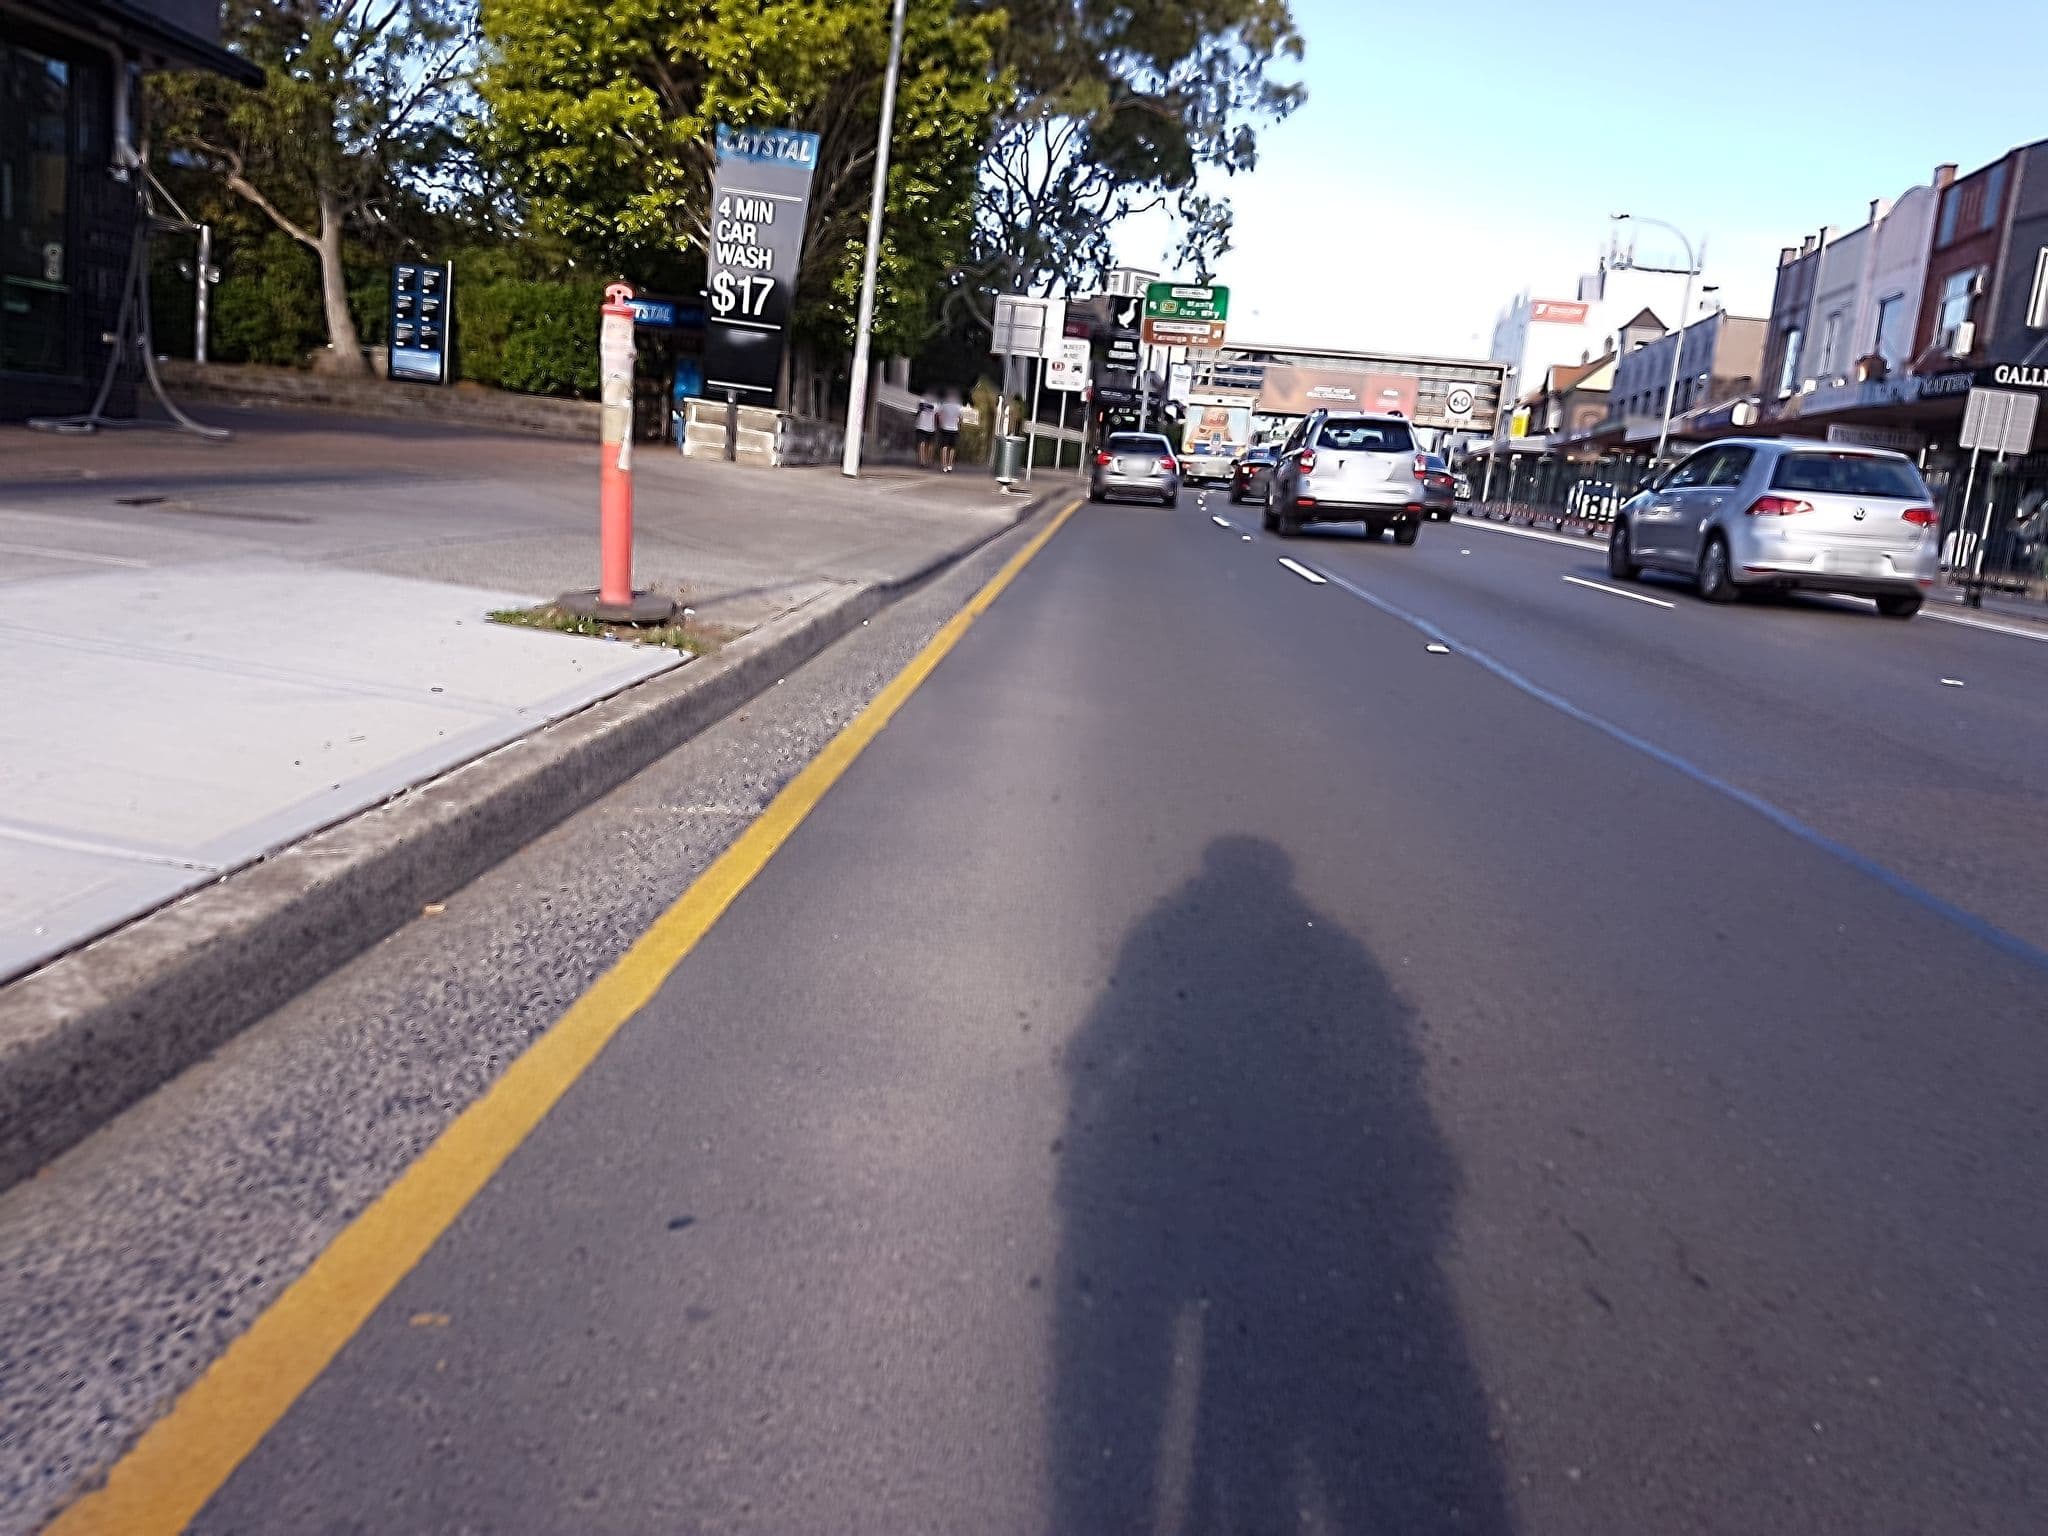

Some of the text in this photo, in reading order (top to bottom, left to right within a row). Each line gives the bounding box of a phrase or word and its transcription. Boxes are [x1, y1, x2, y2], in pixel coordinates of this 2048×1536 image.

[722, 134, 811, 162] CRYSTAL
[718, 197, 773, 224] 4 MIN
[717, 222, 756, 245] CAR
[717, 242, 772, 270] WASH
[710, 269, 775, 316] $17
[1453, 396, 1469, 407] 60
